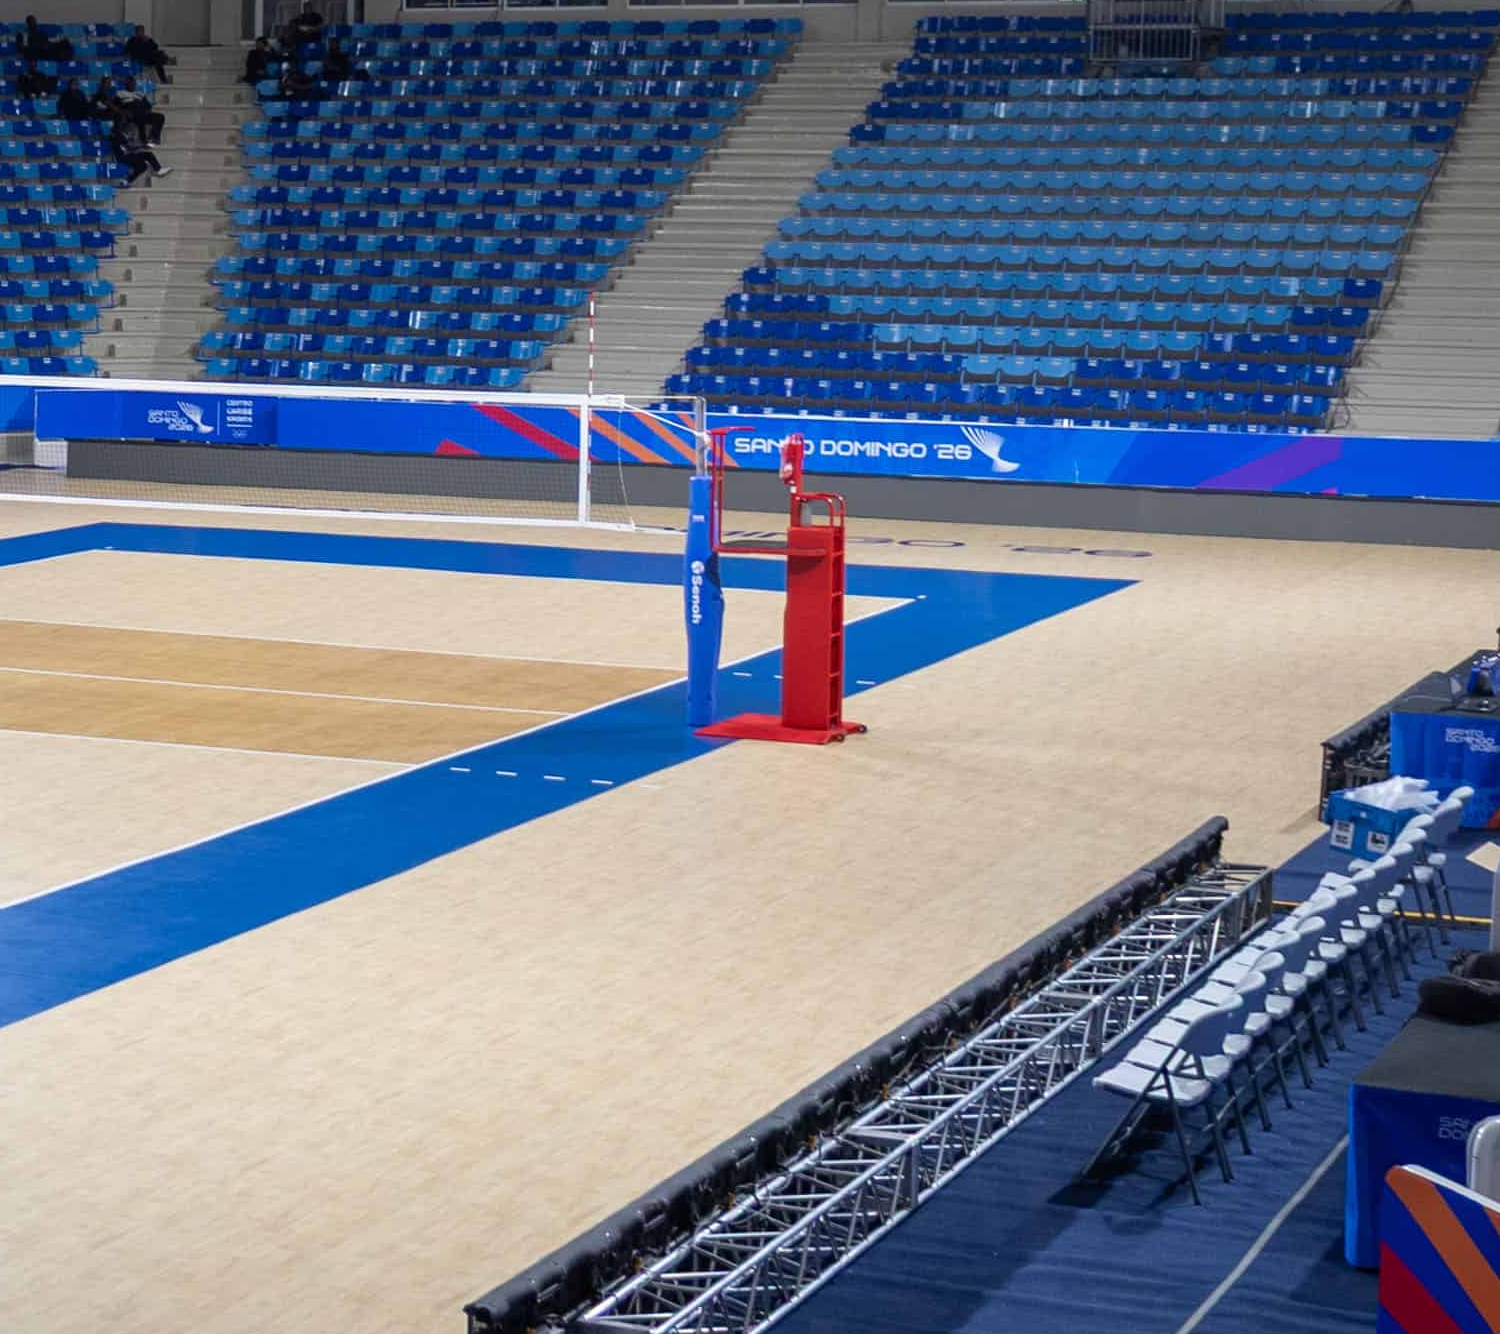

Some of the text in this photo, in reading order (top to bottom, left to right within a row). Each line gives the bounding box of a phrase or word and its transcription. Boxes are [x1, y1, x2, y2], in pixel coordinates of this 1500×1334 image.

[734, 437, 973, 461] SANO DOMINGO '26
[691, 575, 703, 625] Senoh
